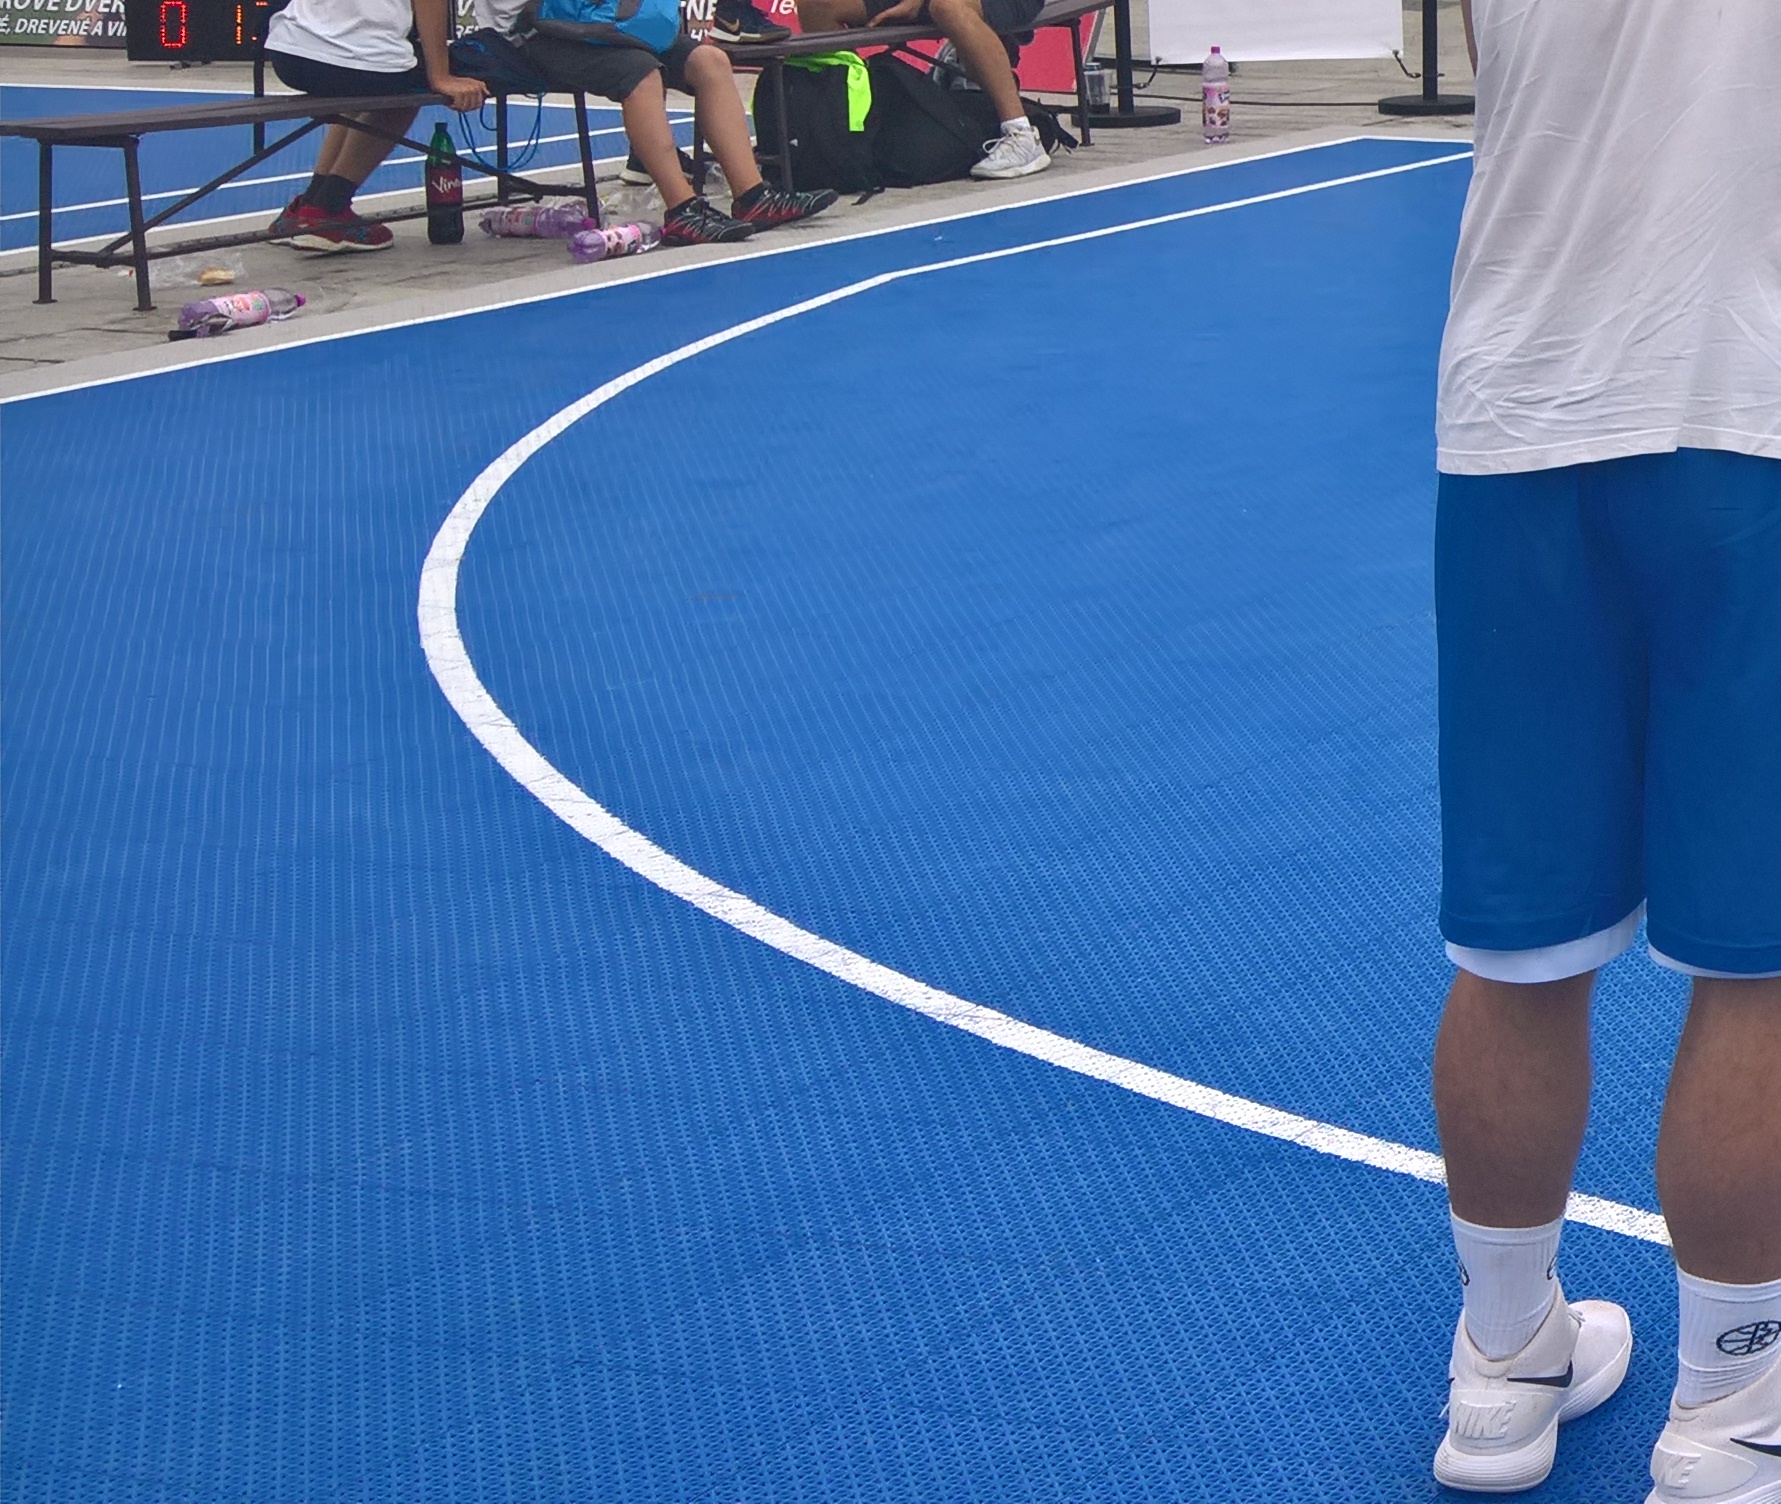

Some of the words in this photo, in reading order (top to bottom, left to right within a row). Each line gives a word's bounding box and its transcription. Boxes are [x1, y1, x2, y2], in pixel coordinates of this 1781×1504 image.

[14, 15, 90, 36] DREVENÉ
[92, 21, 104, 37] A
[160, 0, 187, 48] 0
[1454, 1399, 1517, 1440] NIKE
